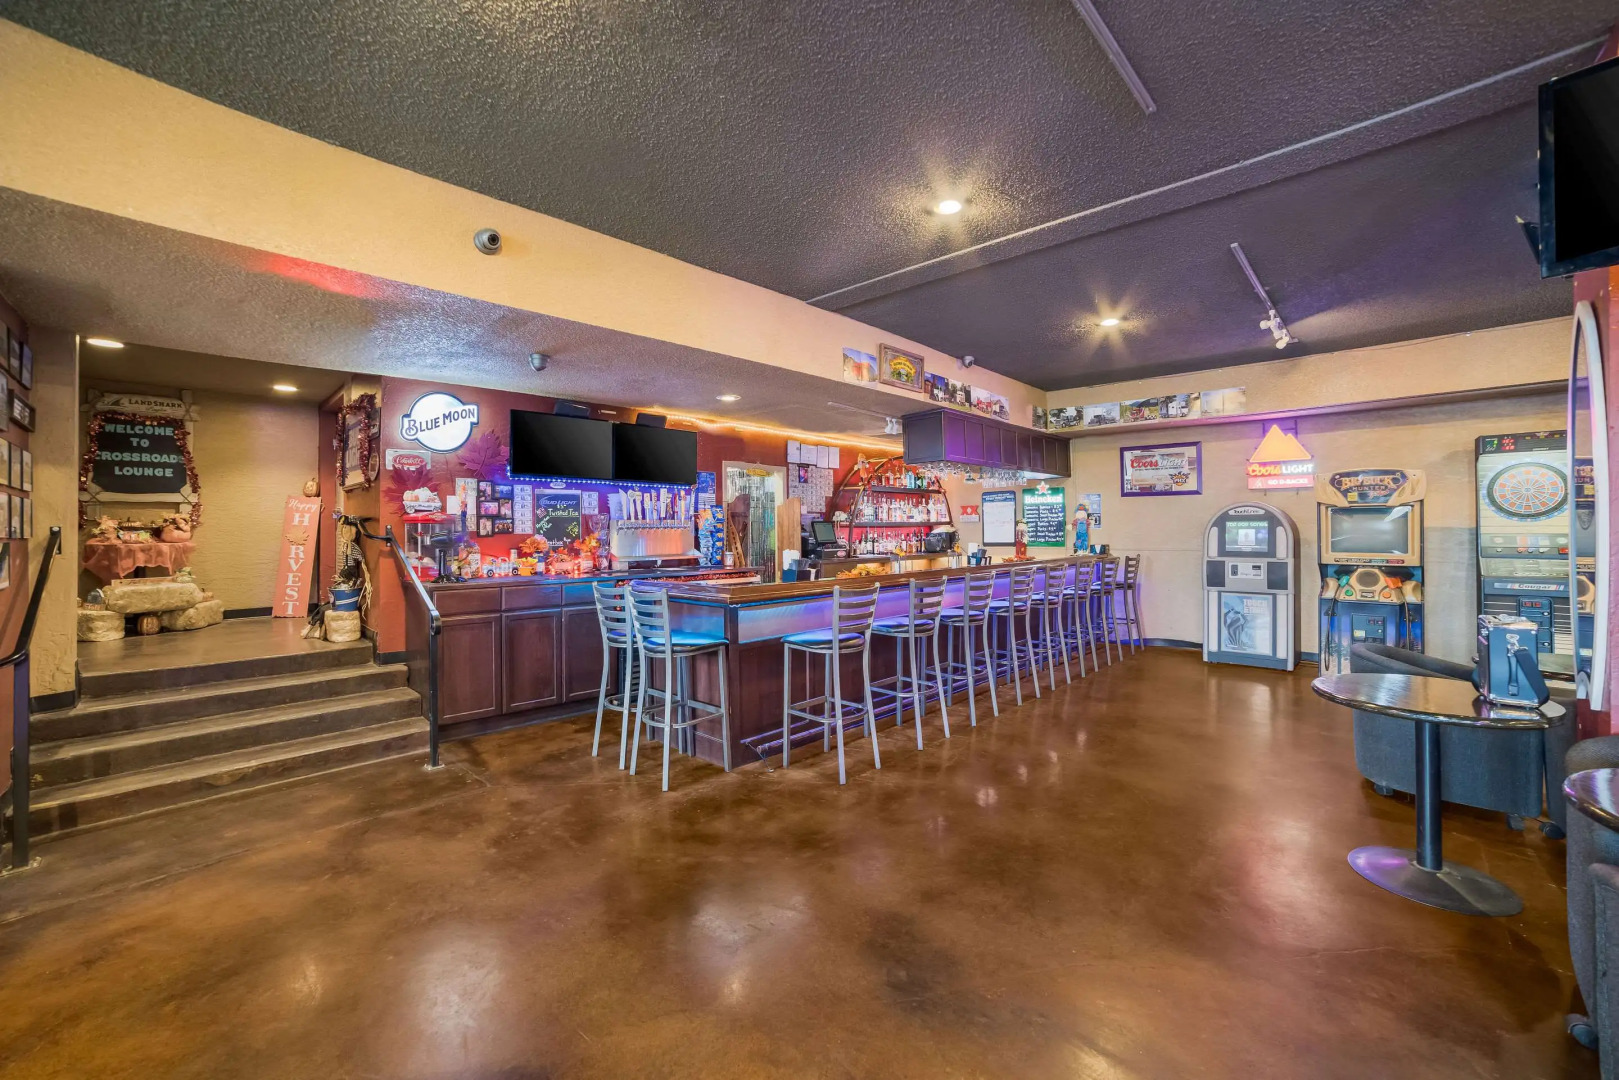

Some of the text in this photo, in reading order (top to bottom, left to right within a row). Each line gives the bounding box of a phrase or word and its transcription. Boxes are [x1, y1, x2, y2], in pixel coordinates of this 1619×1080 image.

[128, 398, 182, 408] LANDSHARK
[405, 408, 476, 437] BLUE MOON
[104, 424, 174, 436] WELCOME
[130, 438, 150, 447] TO
[1131, 458, 1159, 469] Coors
[114, 466, 174, 477] LOUNGE
[1248, 463, 1314, 476] Coors LIGHT
[1363, 476, 1397, 488] BUCK
[1024, 494, 1063, 504] Heineken
[287, 499, 319, 512] Happy
[568, 508, 579, 516] Tea
